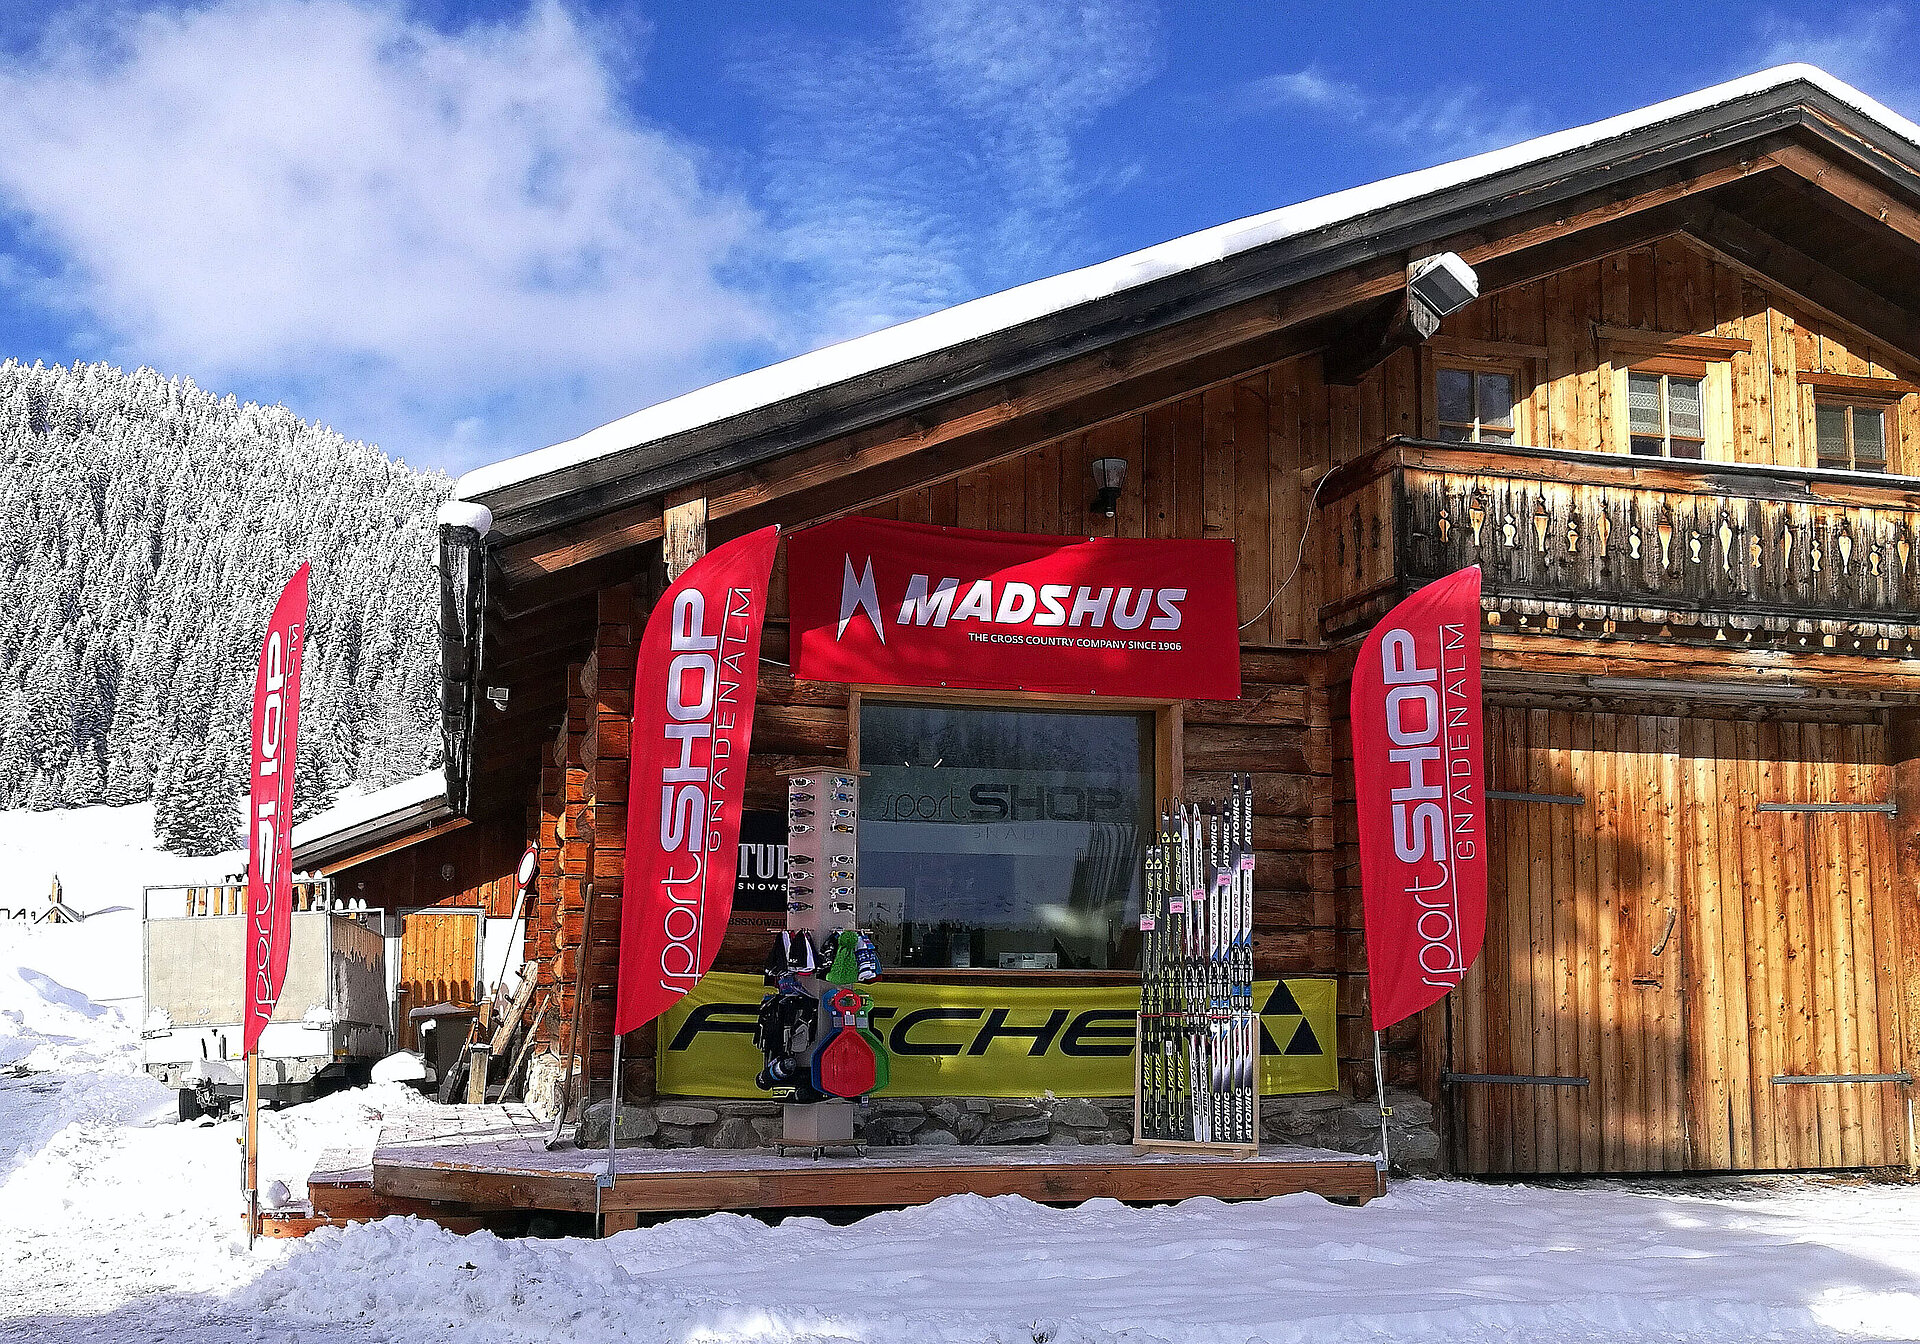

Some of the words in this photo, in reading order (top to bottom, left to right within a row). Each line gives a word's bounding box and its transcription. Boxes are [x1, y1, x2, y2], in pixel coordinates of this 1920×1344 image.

[897, 574, 1187, 631] MADSHUS
[968, 632, 989, 642] THE
[991, 634, 1024, 645] CROSS
[1026, 636, 1076, 647] COUNTRY
[1077, 638, 1127, 649] COMPANY
[1128, 640, 1157, 650] SINCE
[1158, 641, 1182, 651] 1906
[660, 588, 718, 852] SHOP
[707, 587, 752, 853] GNADENALM
[1381, 628, 1446, 864] SHOP
[1445, 623, 1476, 861] GNADENALM
[881, 788, 963, 824] sport
[969, 784, 1121, 822] SHOP
[1232, 797, 1240, 846] ATOMIC
[1244, 797, 1252, 846] ATOMIC
[1210, 822, 1218, 868] ATOMIC
[659, 852, 703, 995] sport
[1405, 862, 1467, 989] sport
[1214, 1092, 1222, 1141] ATOMIC
[1223, 1091, 1231, 1141] ATOMIC
[1235, 1087, 1243, 1140] ATOMIC
